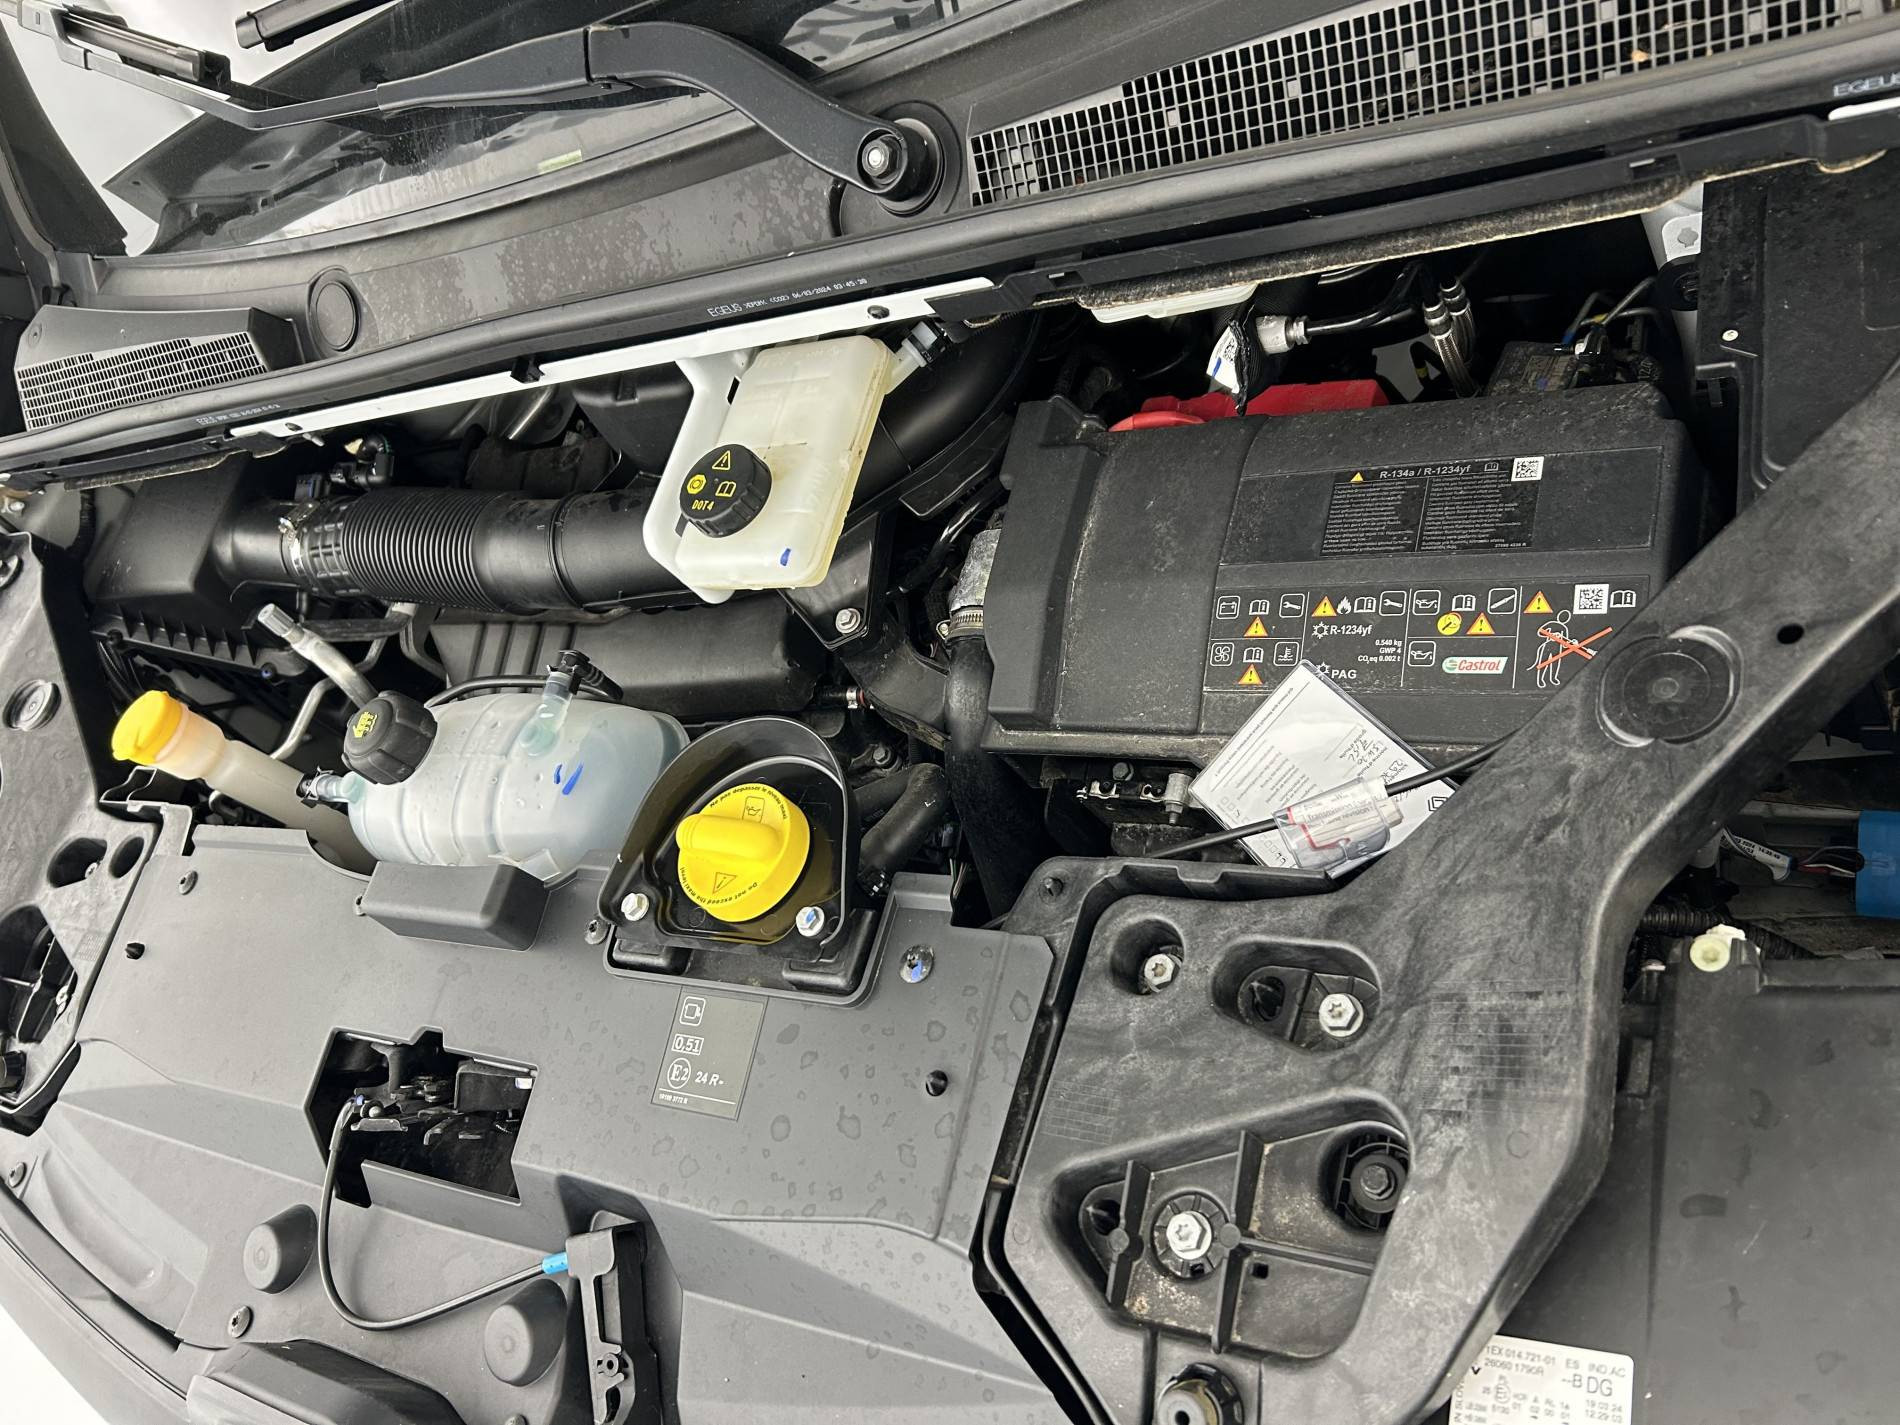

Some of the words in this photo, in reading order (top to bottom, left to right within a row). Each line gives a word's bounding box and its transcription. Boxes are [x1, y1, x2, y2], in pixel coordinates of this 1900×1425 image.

[1379, 468, 1415, 479] R-134a
[1423, 464, 1472, 476] R-1234yf
[1329, 623, 1373, 637] R-1234yf
[1394, 639, 1403, 648] kg
[1457, 659, 1502, 672] Castrol
[1331, 669, 1357, 679] PAG
[674, 1036, 700, 1053] 0,51
[695, 1071, 709, 1084] 24
[1587, 1376, 1613, 1397] DG
